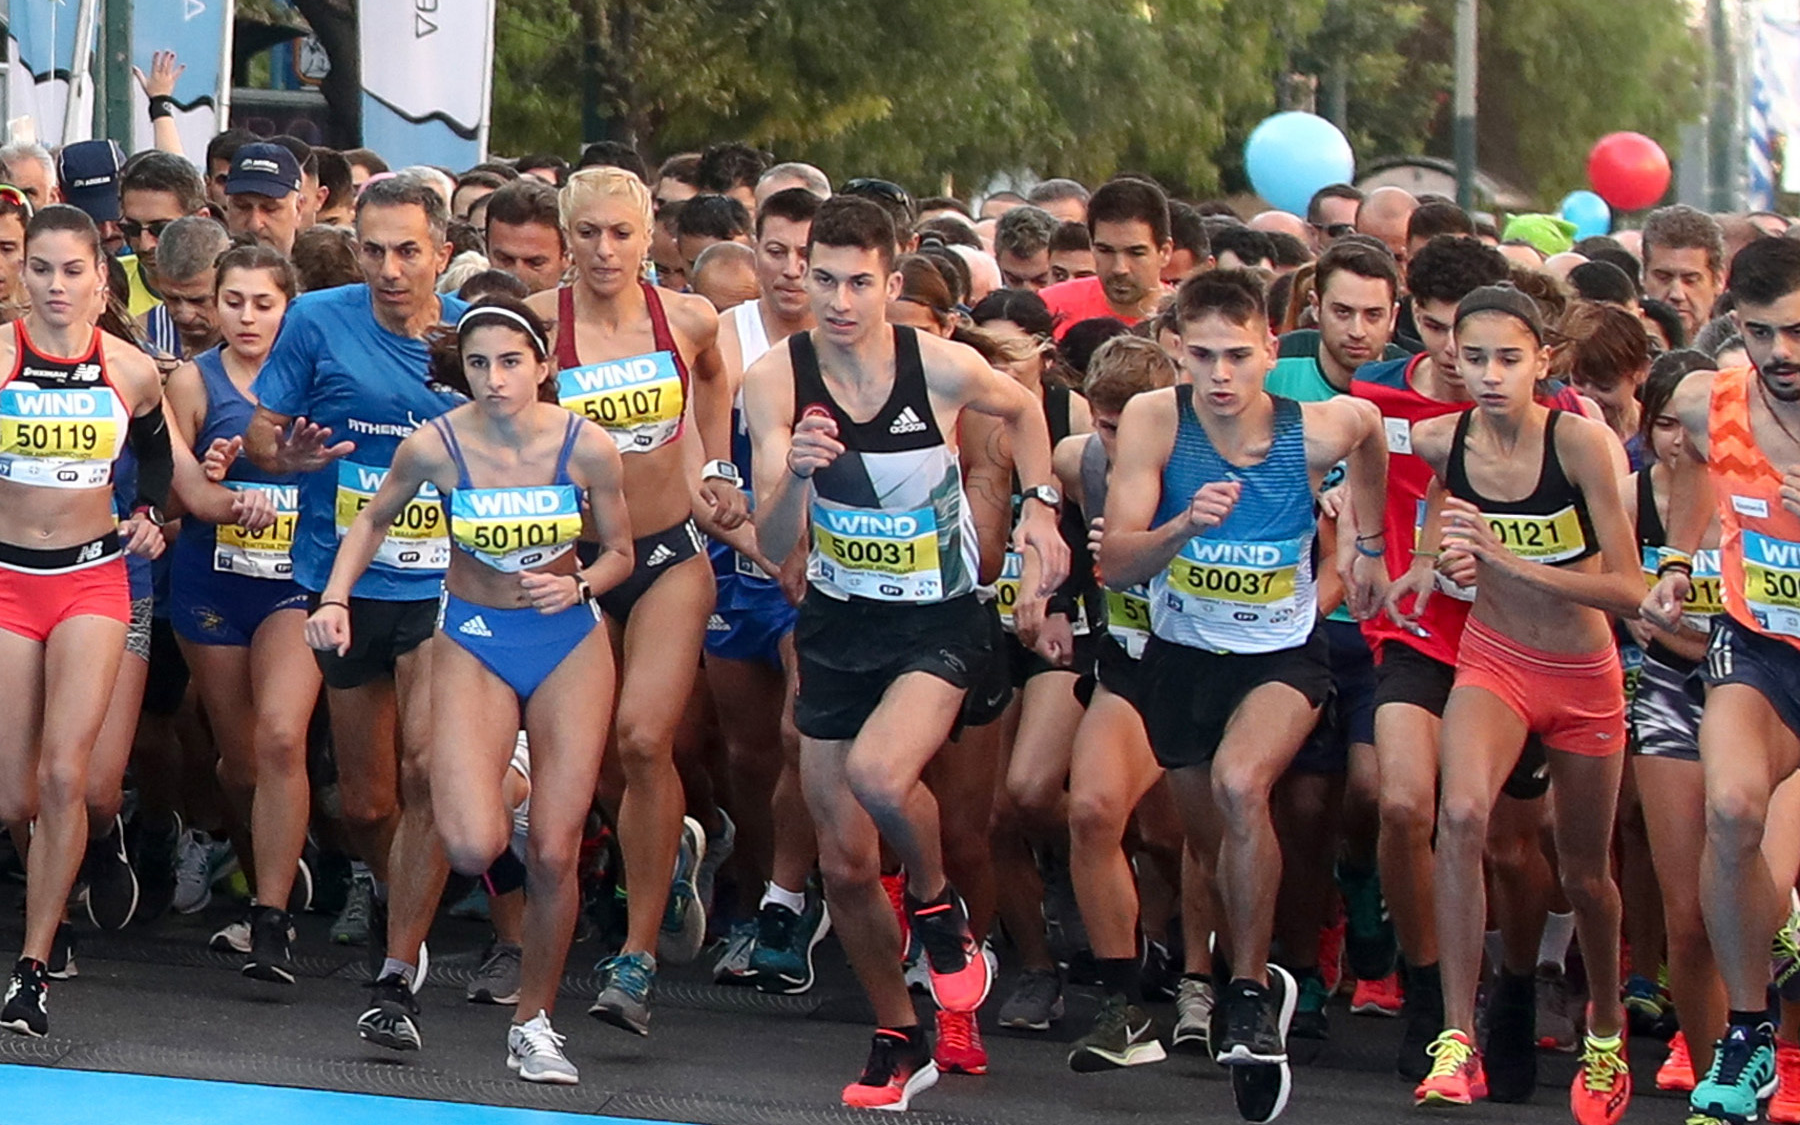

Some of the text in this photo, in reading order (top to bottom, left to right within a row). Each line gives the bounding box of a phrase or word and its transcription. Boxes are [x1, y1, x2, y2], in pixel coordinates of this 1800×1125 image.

[573, 358, 657, 392] WIND
[14, 393, 96, 416] WIND
[584, 387, 662, 422] 50107
[16, 424, 97, 450] 50119
[470, 490, 560, 517] WIND
[474, 523, 559, 549] 50101
[827, 512, 918, 537] WIND
[1490, 520, 1560, 547] 0121
[832, 536, 916, 565] 50031
[1190, 538, 1282, 566] WIND
[1188, 566, 1278, 596] 50037
